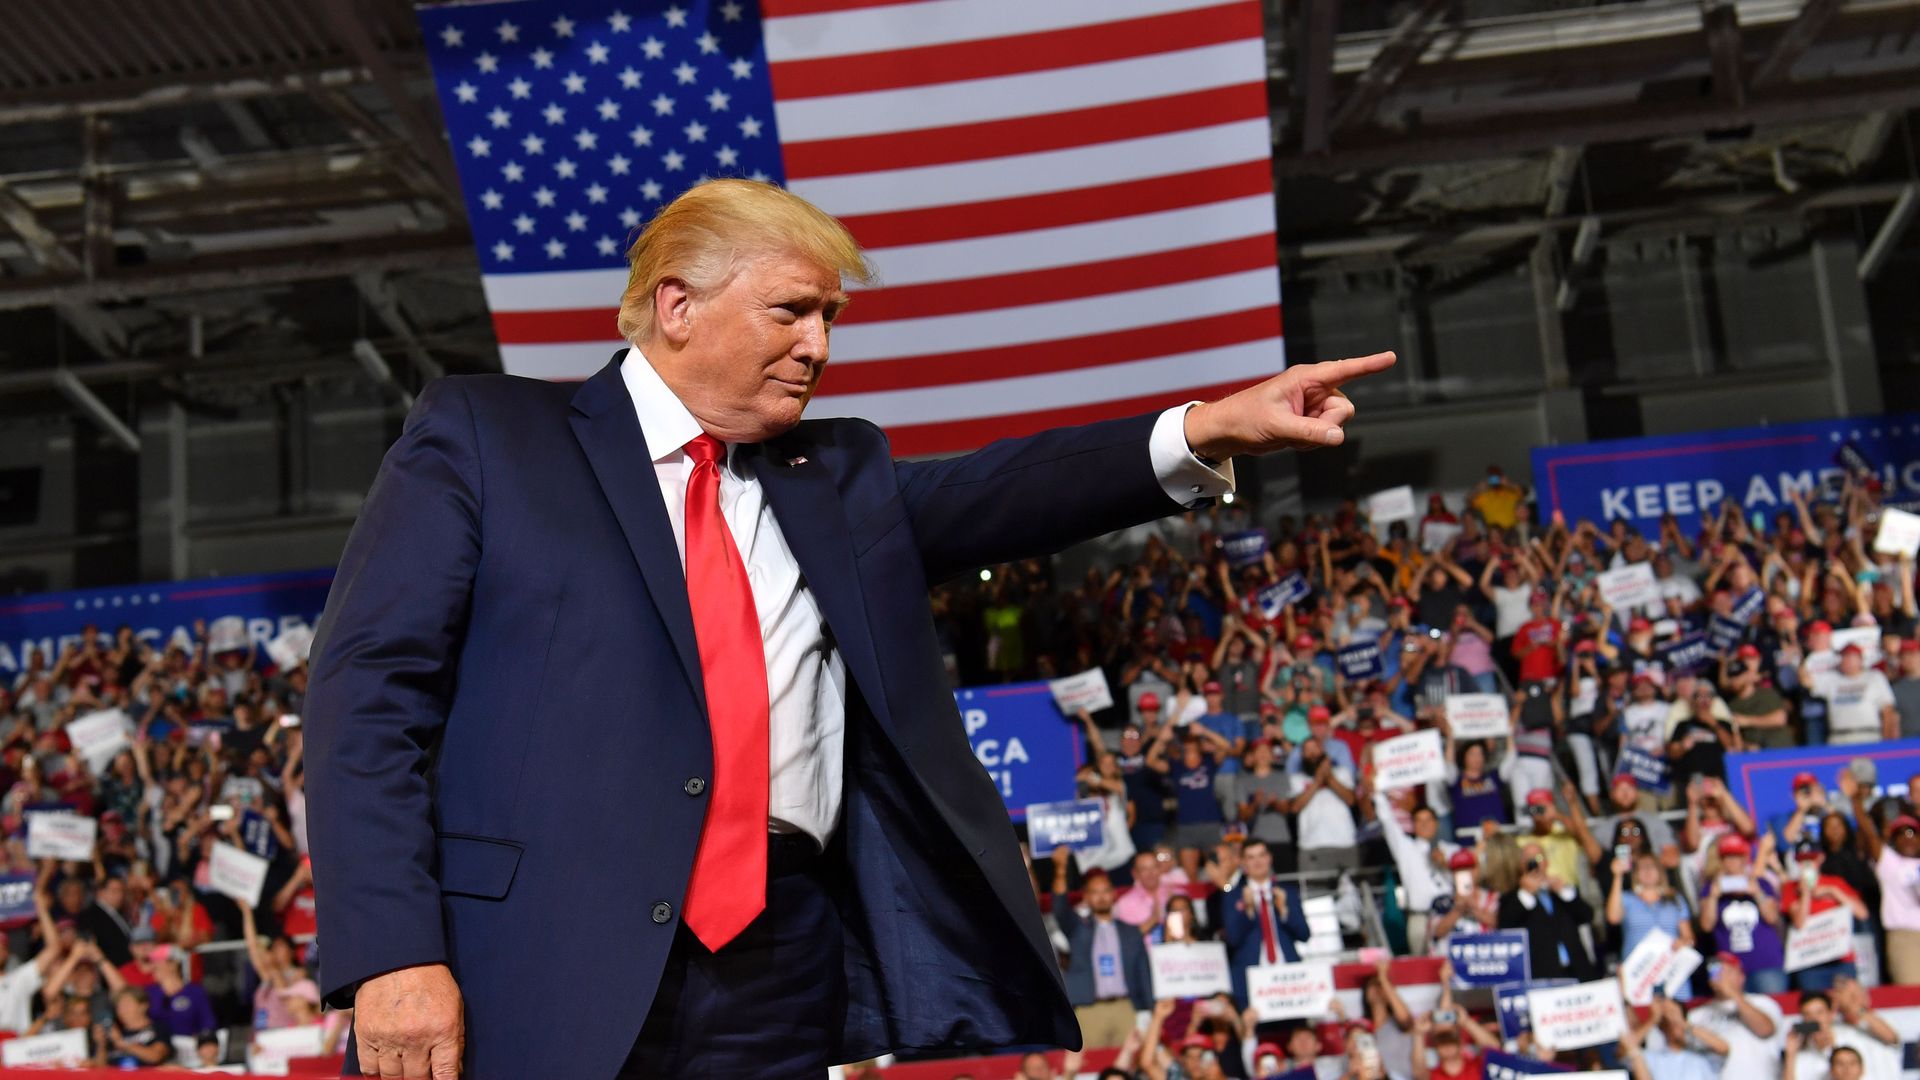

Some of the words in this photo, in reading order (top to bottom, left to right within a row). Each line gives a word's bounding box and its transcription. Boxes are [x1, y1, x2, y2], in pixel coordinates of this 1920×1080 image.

[1601, 479, 1724, 521] KEEP
[961, 709, 988, 737] P
[970, 737, 1029, 767] CA
[1033, 810, 1101, 830] TRUMP
[1451, 942, 1524, 961] TRUMP
[1271, 972, 1306, 983] KEEP
[1467, 961, 1509, 976] 2020
[1256, 983, 1327, 998] AMERICA
[1555, 994, 1594, 1007] KEEP
[1540, 1004, 1616, 1025] AMERICA
